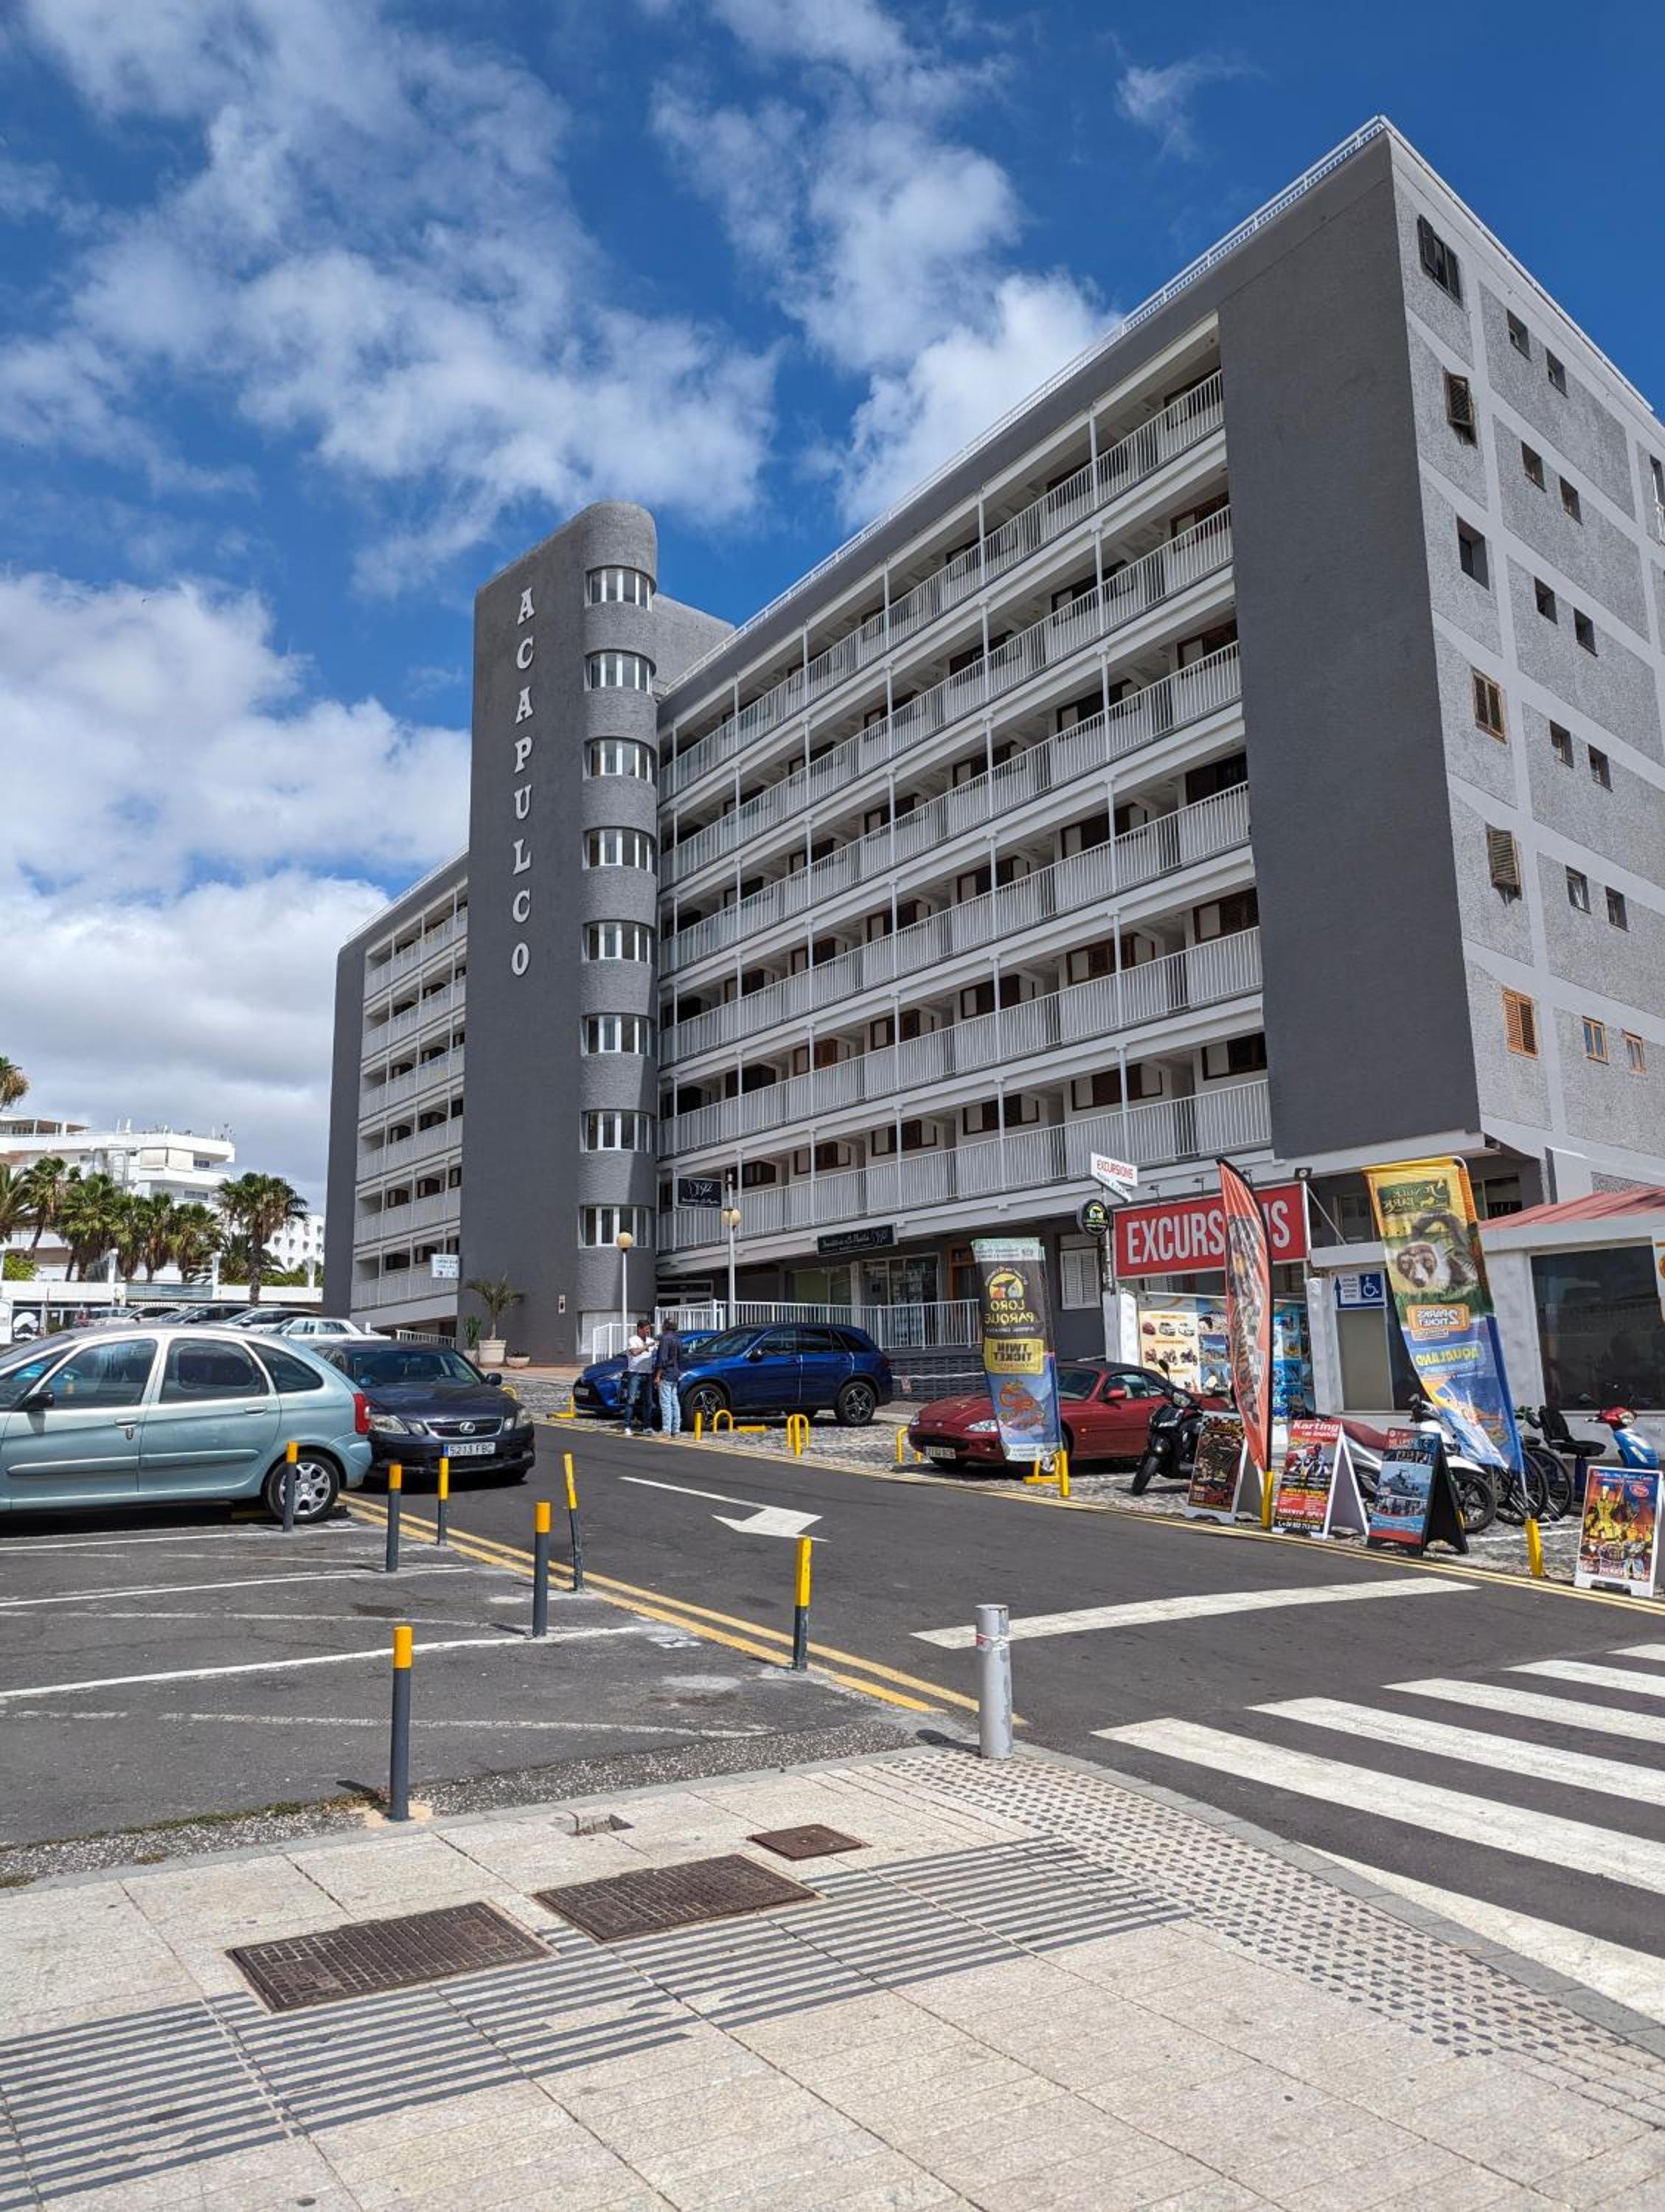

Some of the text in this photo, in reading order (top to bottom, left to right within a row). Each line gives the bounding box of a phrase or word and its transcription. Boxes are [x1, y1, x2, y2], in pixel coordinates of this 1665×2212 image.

[510, 587, 535, 976] ACAPULCO
[1096, 1160, 1133, 1179] EXCURSIONS
[1126, 1200, 1290, 1265] EXCURSS
[1293, 1420, 1339, 1433] Karting
